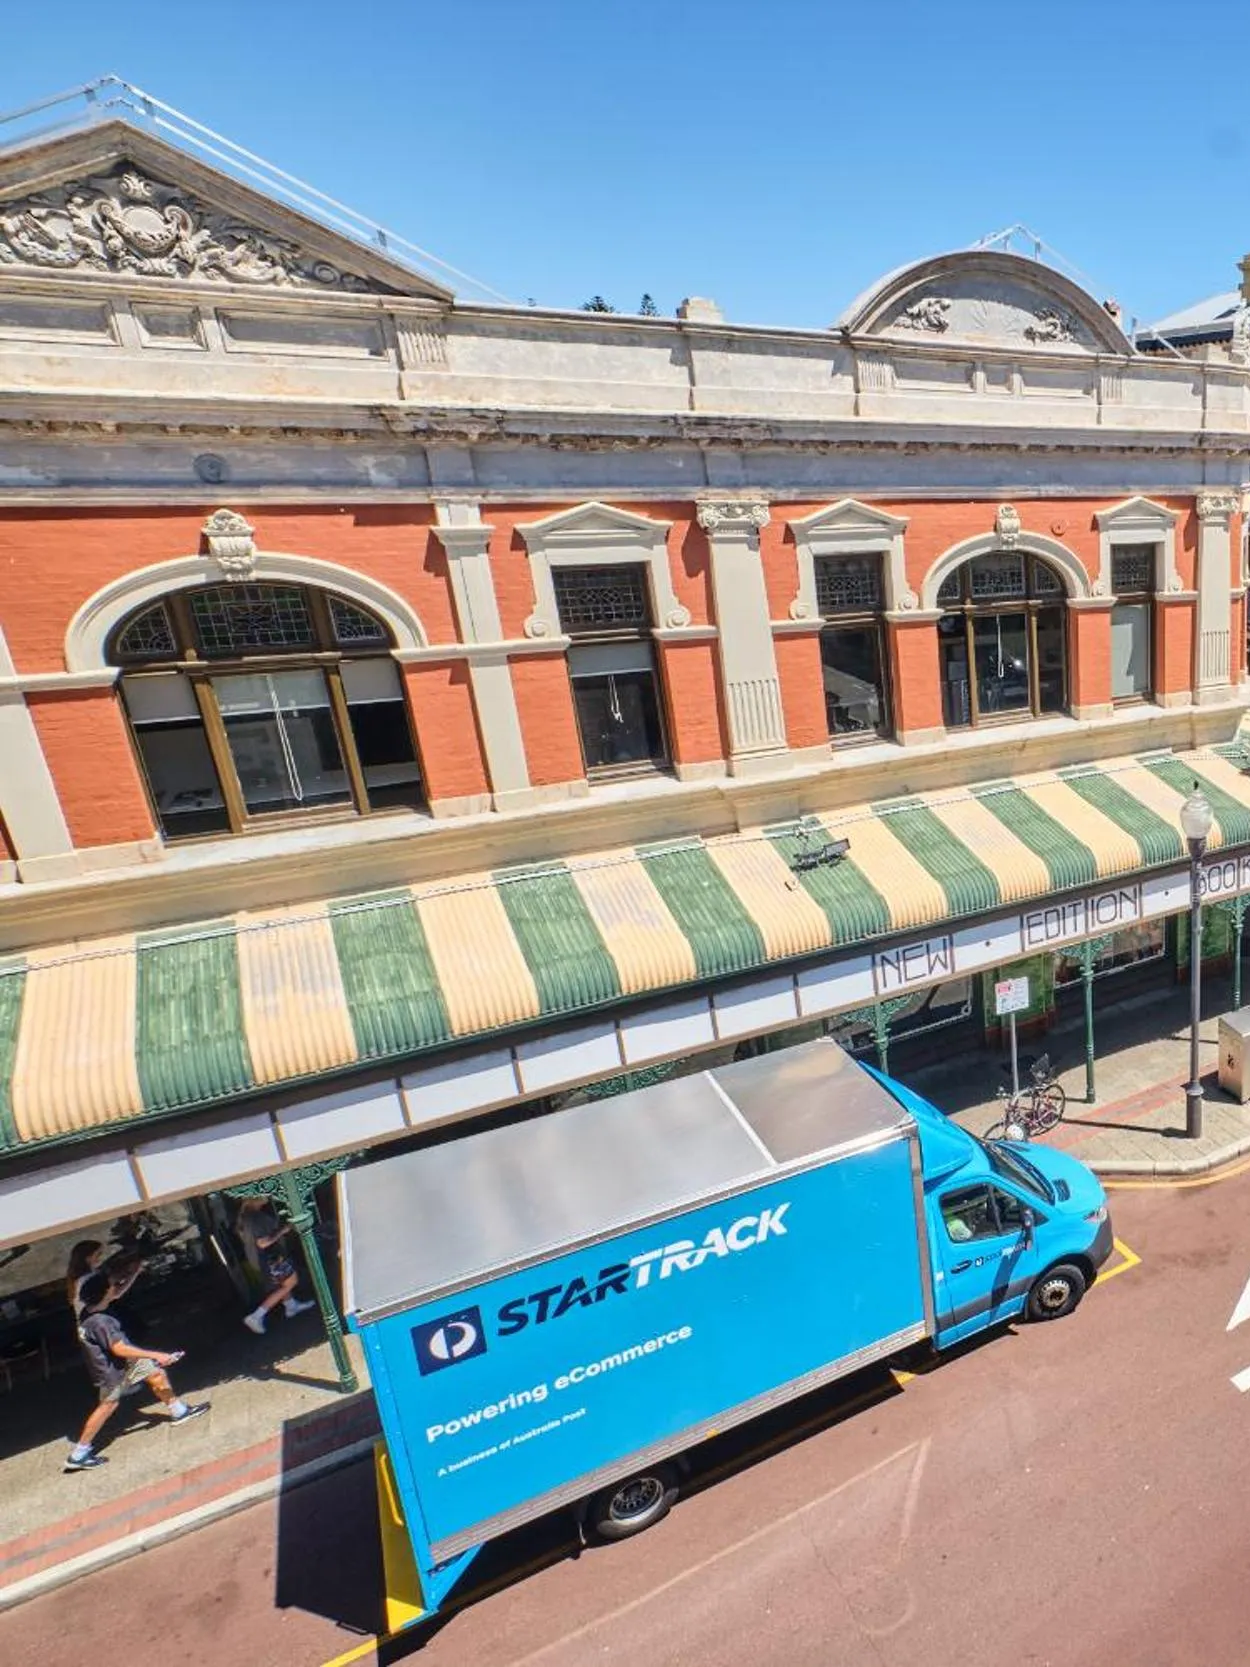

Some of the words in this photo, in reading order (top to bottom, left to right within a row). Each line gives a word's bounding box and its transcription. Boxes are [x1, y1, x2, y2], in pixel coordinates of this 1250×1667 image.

[881, 938, 948, 988] NEW
[1026, 887, 1138, 945] EDITION
[497, 1202, 791, 1336] STARTRACK
[426, 1382, 548, 1443] Powering
[554, 1325, 693, 1390] eCommerce
[437, 1467, 447, 1477] A
[448, 1446, 498, 1473] business
[499, 1439, 511, 1450] of
[513, 1419, 561, 1445] Australia
[562, 1407, 586, 1423] Post
